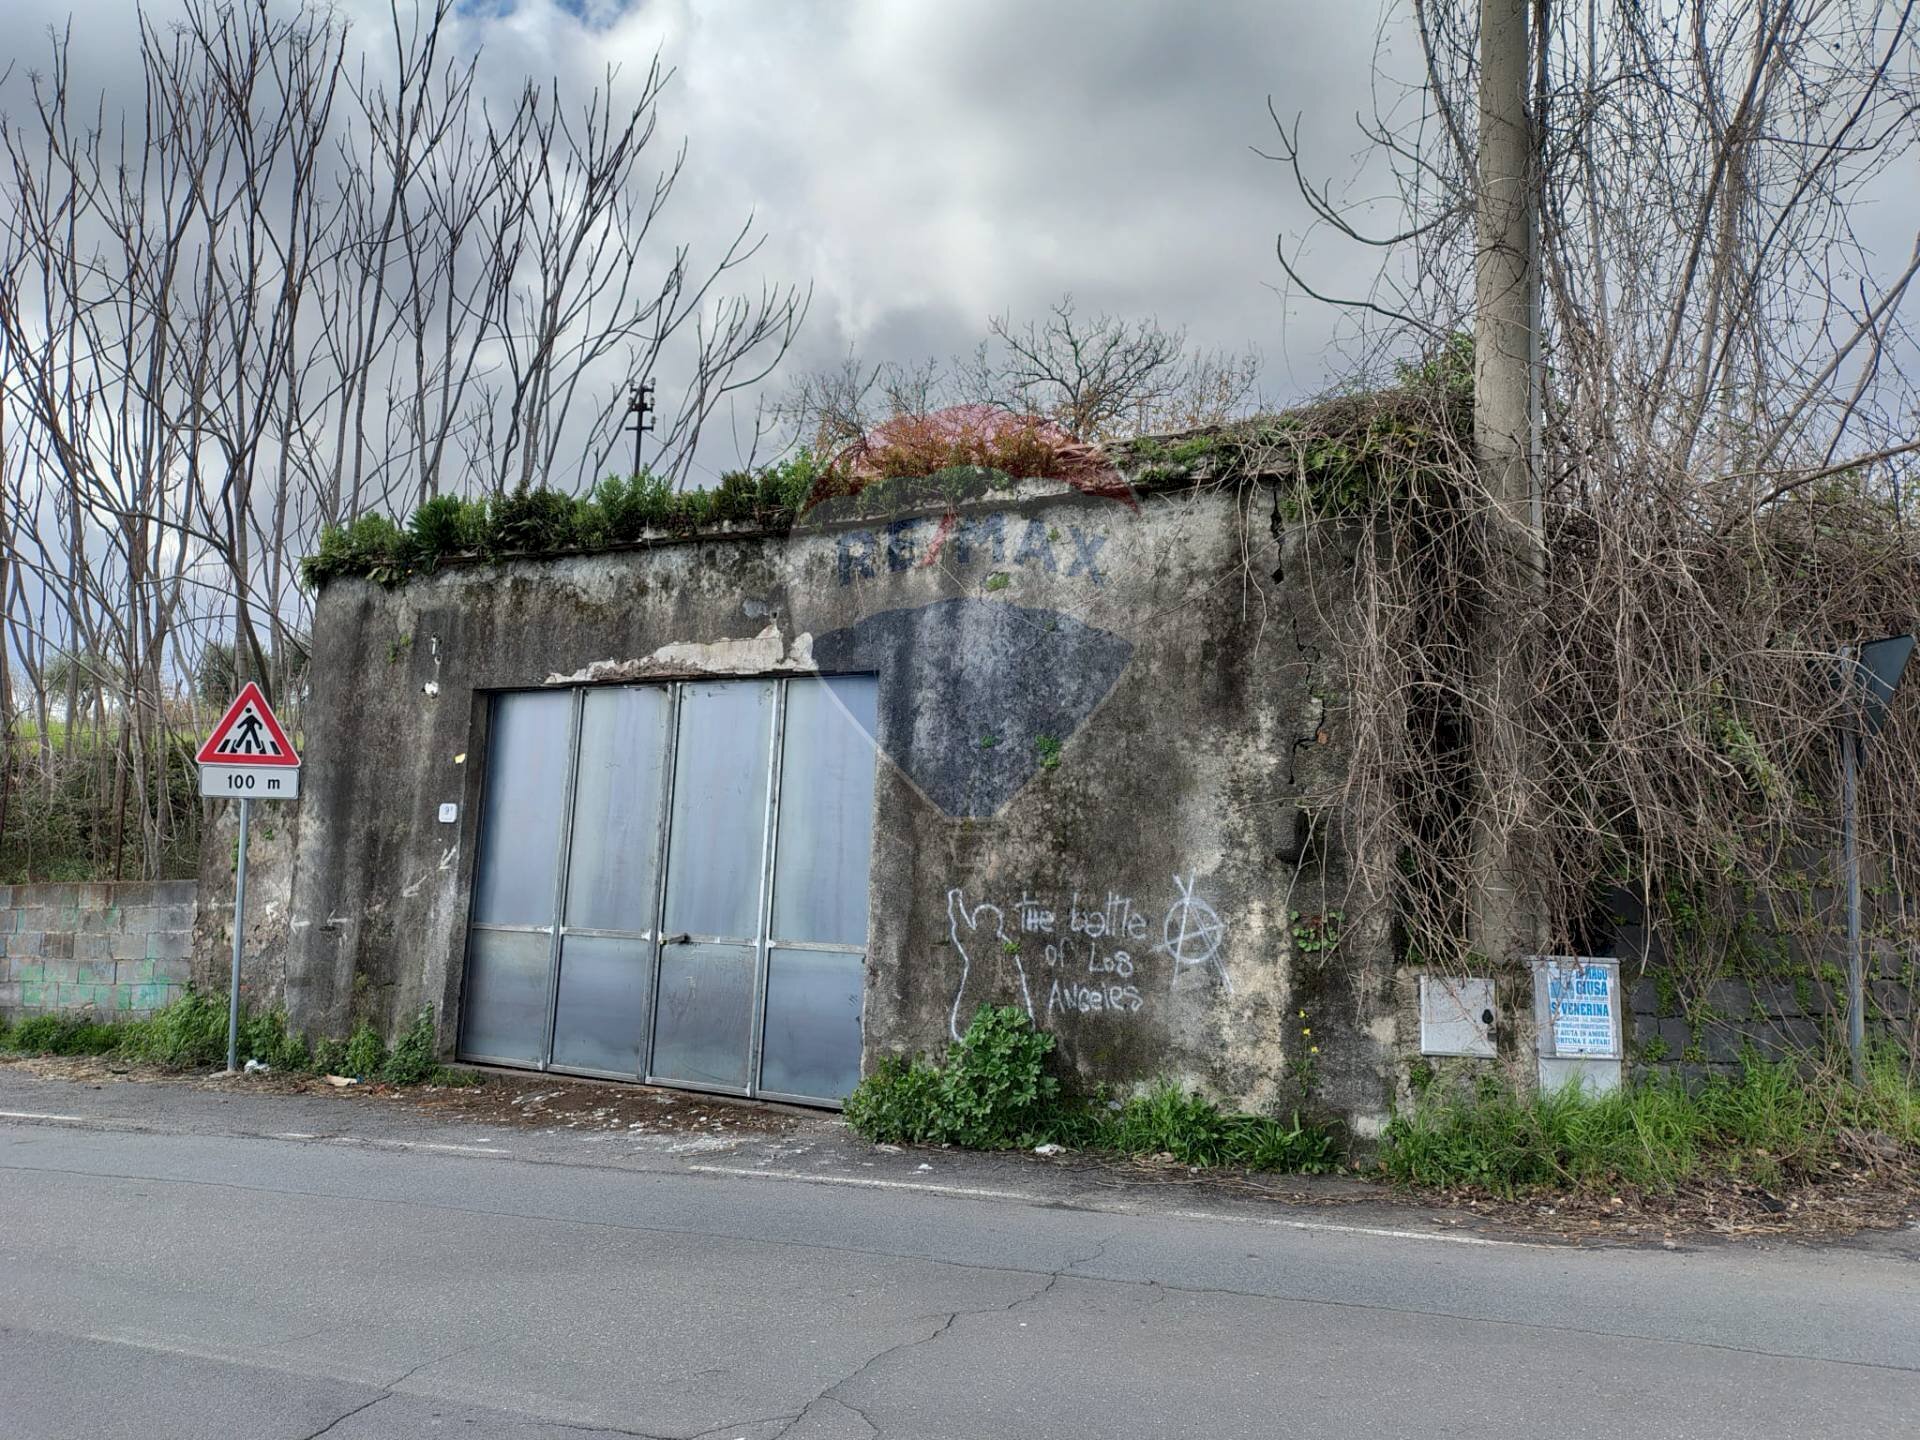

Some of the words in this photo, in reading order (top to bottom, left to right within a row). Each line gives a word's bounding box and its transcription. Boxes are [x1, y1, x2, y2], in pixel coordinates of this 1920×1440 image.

[228, 774, 255, 789] 100
[267, 779, 280, 789] m
[1576, 981, 1608, 996] GIUSA
